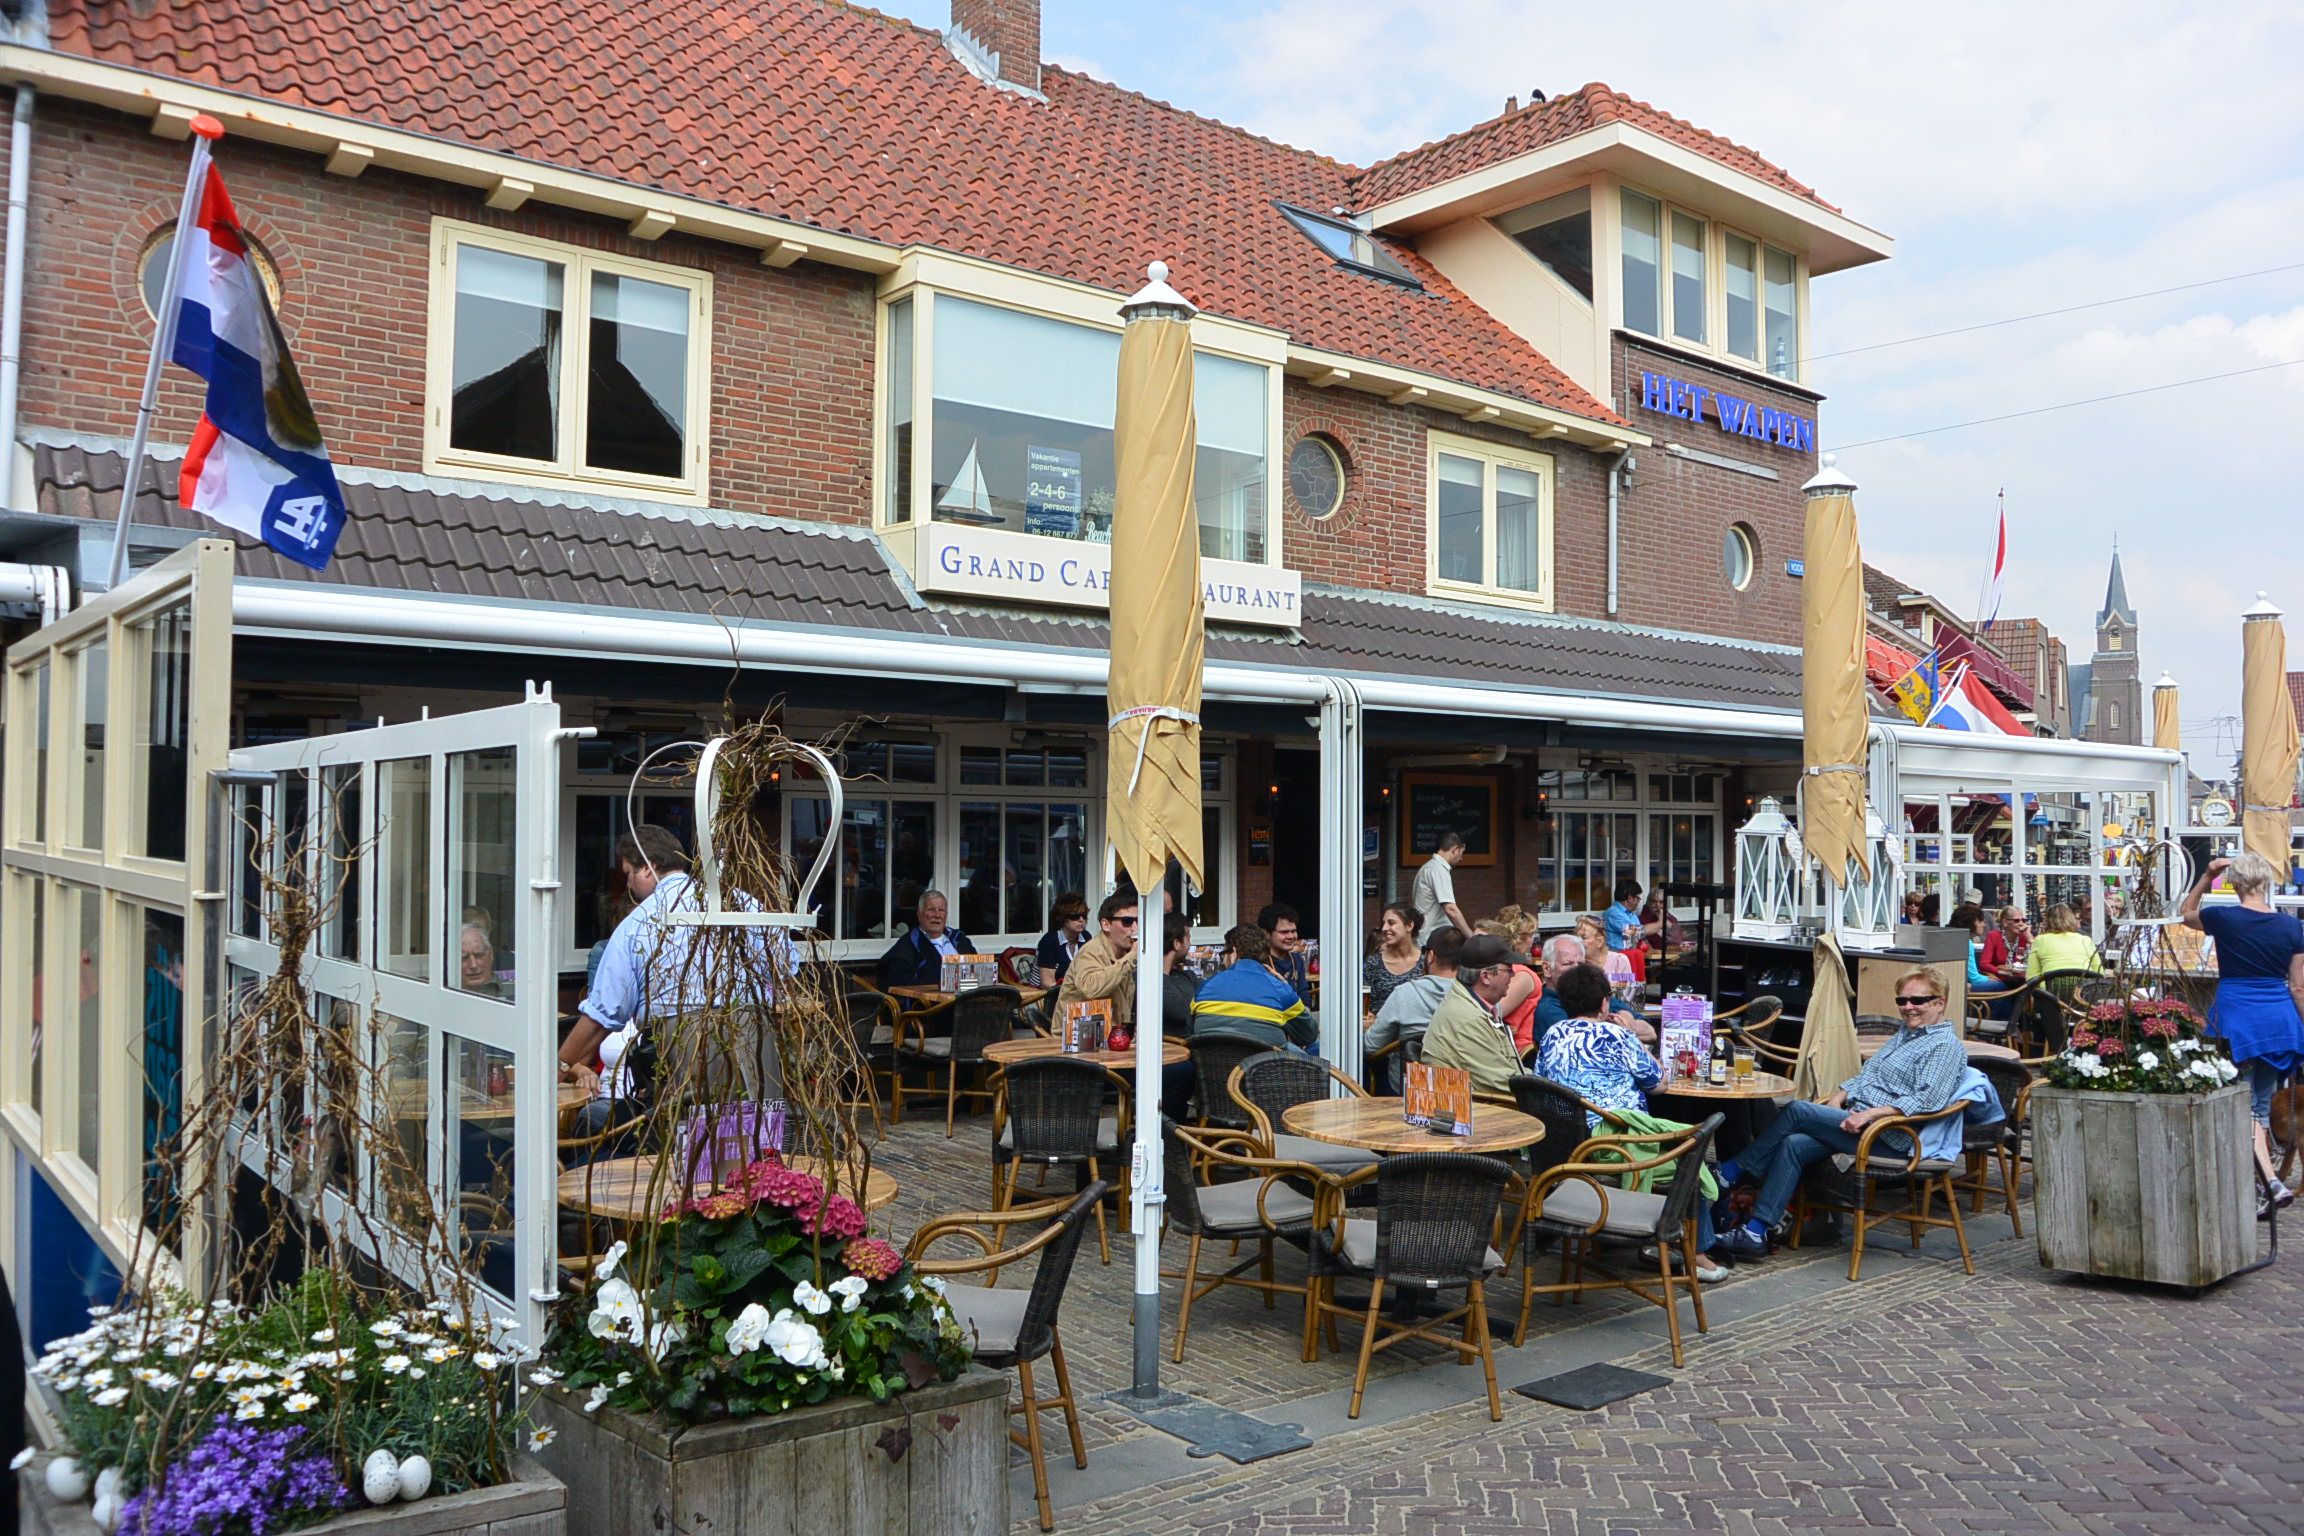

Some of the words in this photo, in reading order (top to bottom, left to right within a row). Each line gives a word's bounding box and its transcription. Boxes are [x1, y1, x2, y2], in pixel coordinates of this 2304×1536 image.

[1641, 371, 1709, 423] HET
[1712, 391, 1815, 454] WAPEN
[1031, 451, 1060, 462] Vakantie
[1029, 482, 1066, 500] 2-4-6
[940, 545, 1045, 583] GRAND
[1060, 559, 1111, 590] CAF
[1203, 582, 1295, 611] AURANT
